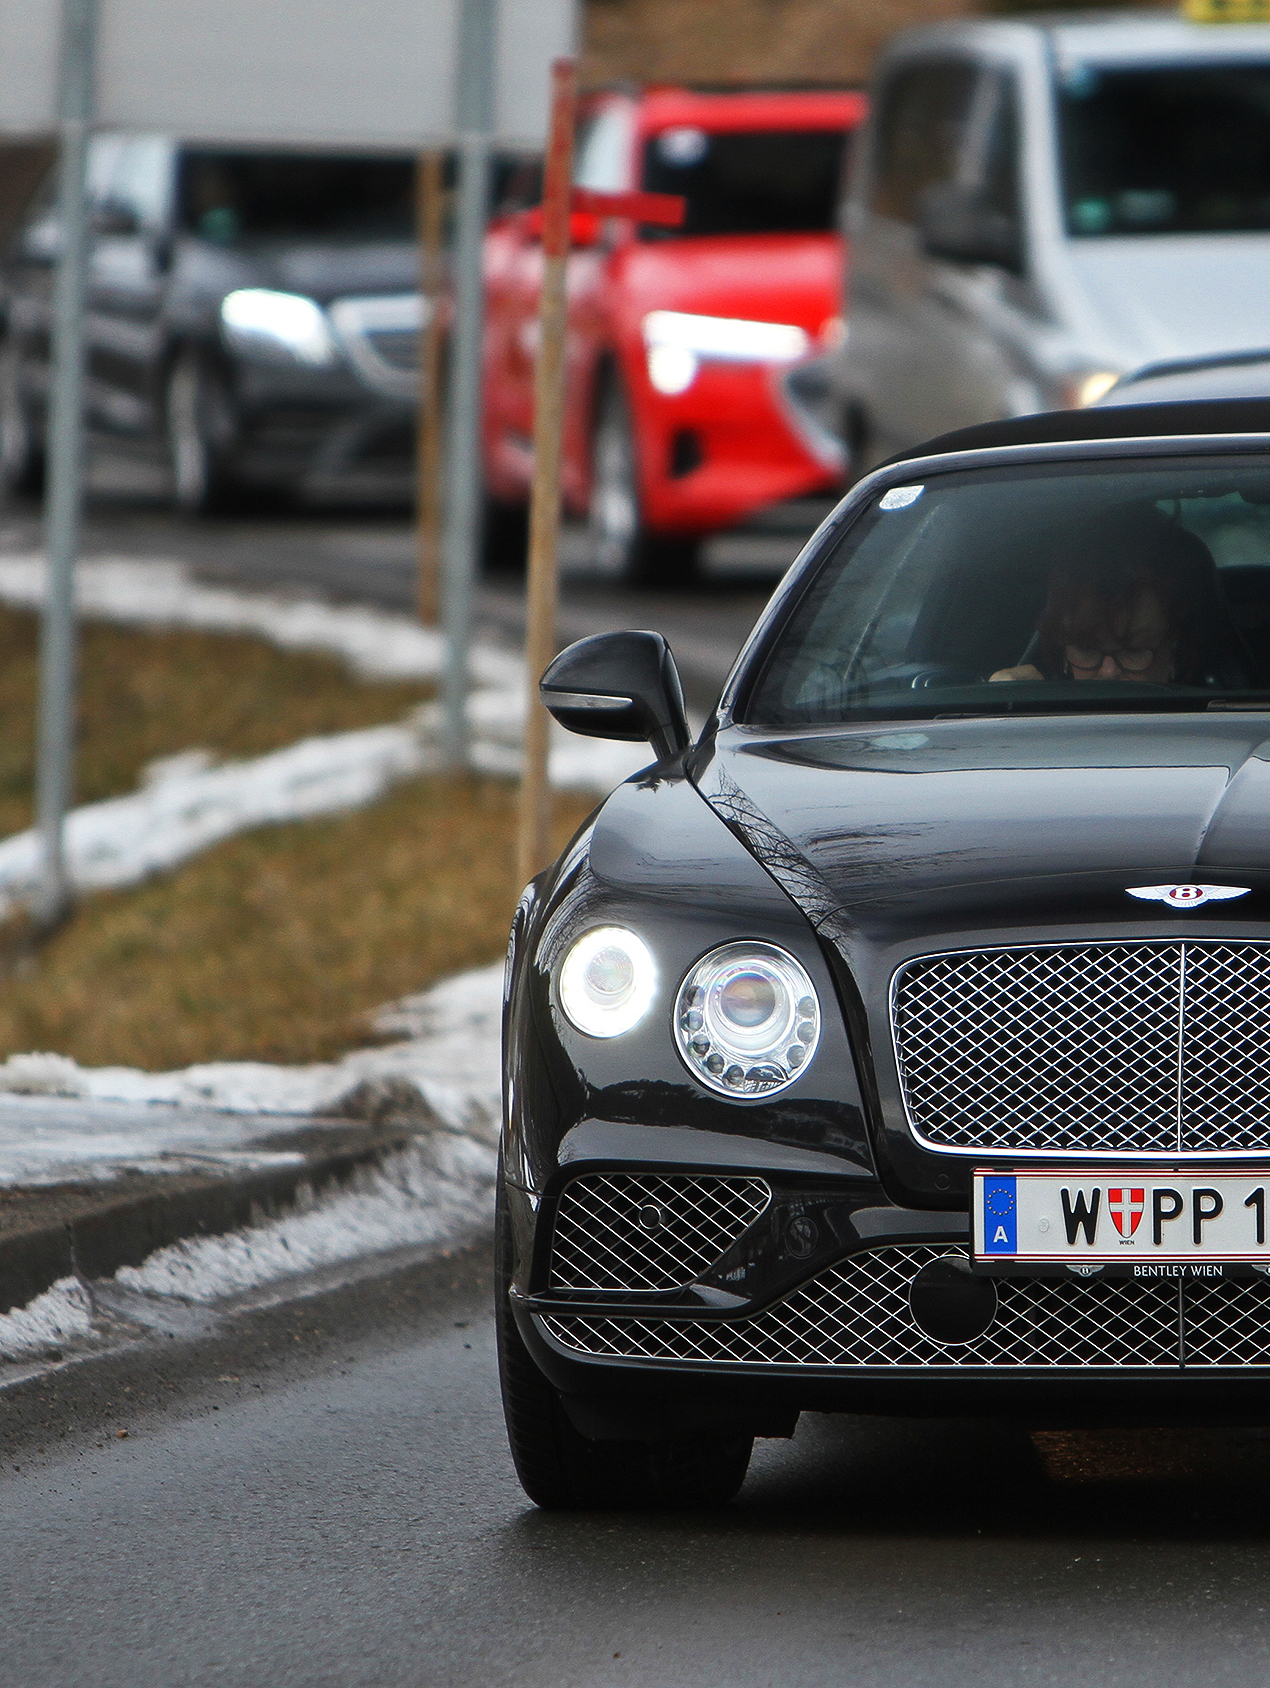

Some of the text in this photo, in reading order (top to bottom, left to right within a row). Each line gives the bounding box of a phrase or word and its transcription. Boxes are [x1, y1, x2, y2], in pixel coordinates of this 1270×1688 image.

[1060, 1187, 1101, 1246] W
[1152, 1188, 1224, 1246] PP
[993, 1225, 1009, 1243] A
[1118, 1239, 1136, 1247] WIEN
[1133, 1265, 1223, 1277] BENTLEY WIEN
